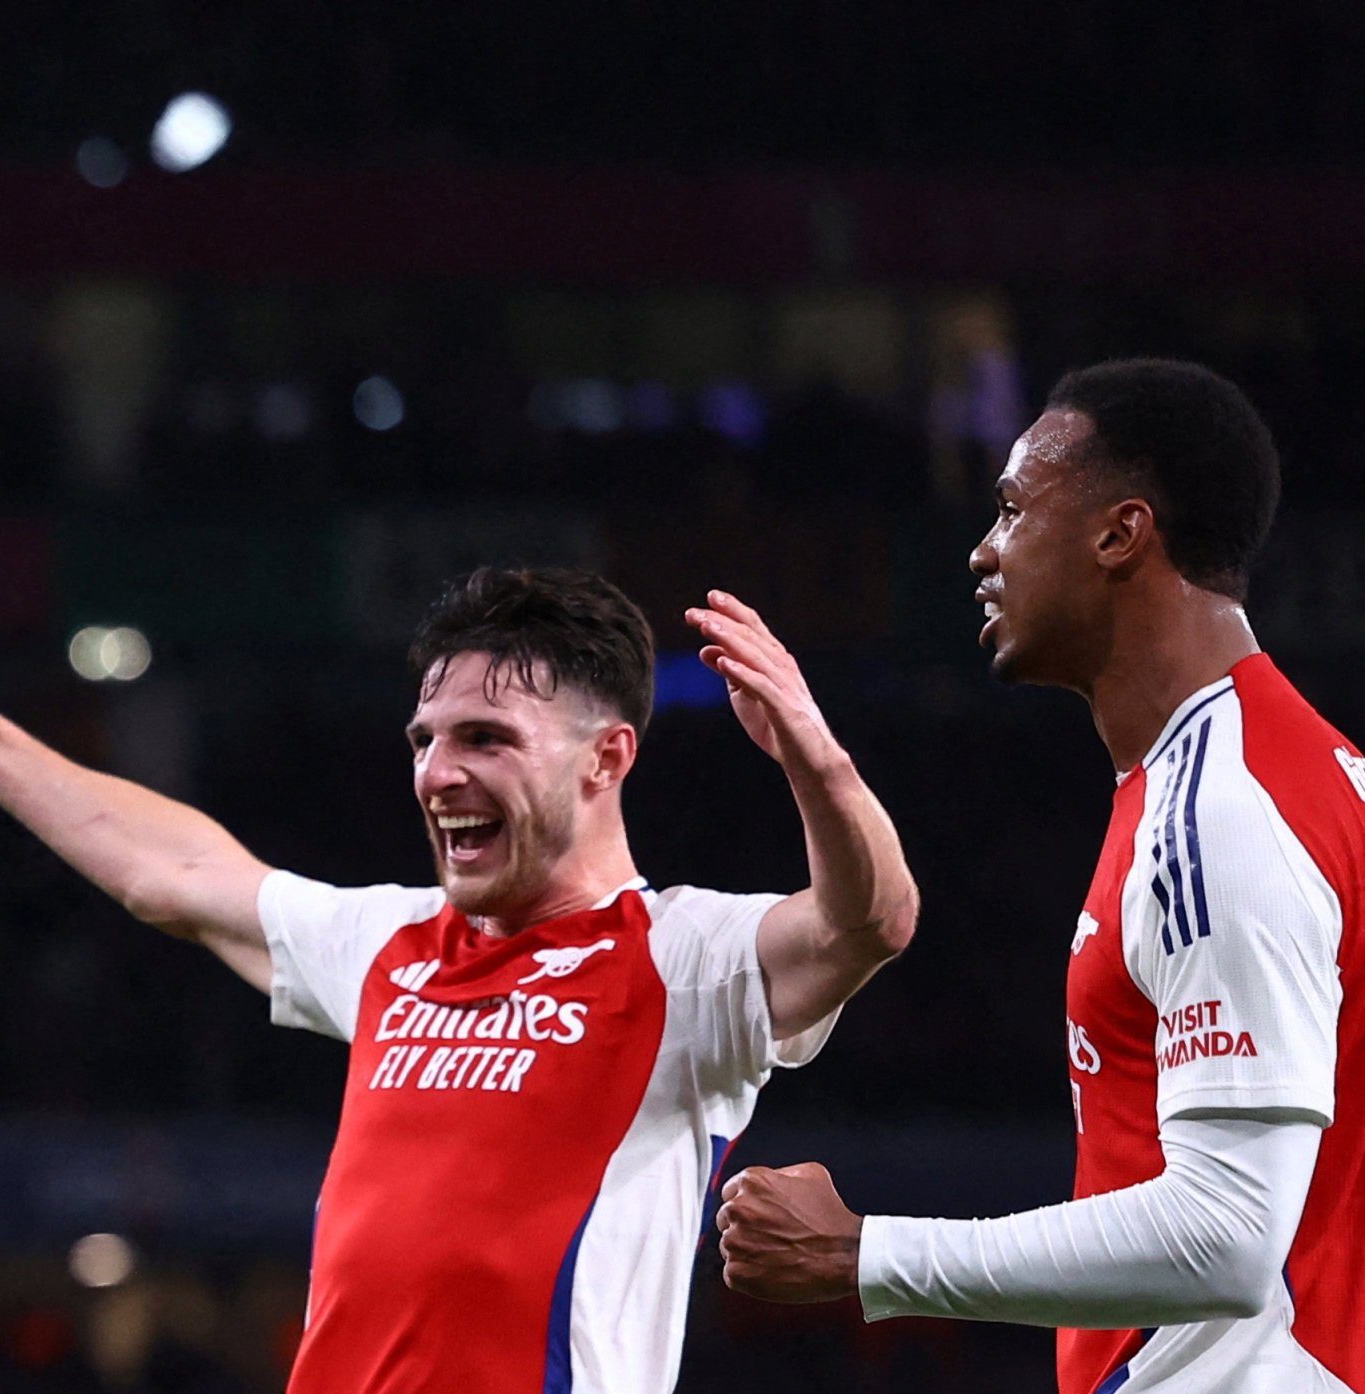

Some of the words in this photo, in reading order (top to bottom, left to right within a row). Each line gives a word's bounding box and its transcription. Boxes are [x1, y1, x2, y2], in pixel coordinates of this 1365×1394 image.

[1160, 999, 1222, 1039] VISIT
[368, 1044, 428, 1090] FLY
[416, 1045, 537, 1093] BETTER
[1156, 1030, 1258, 1074] WANDA
